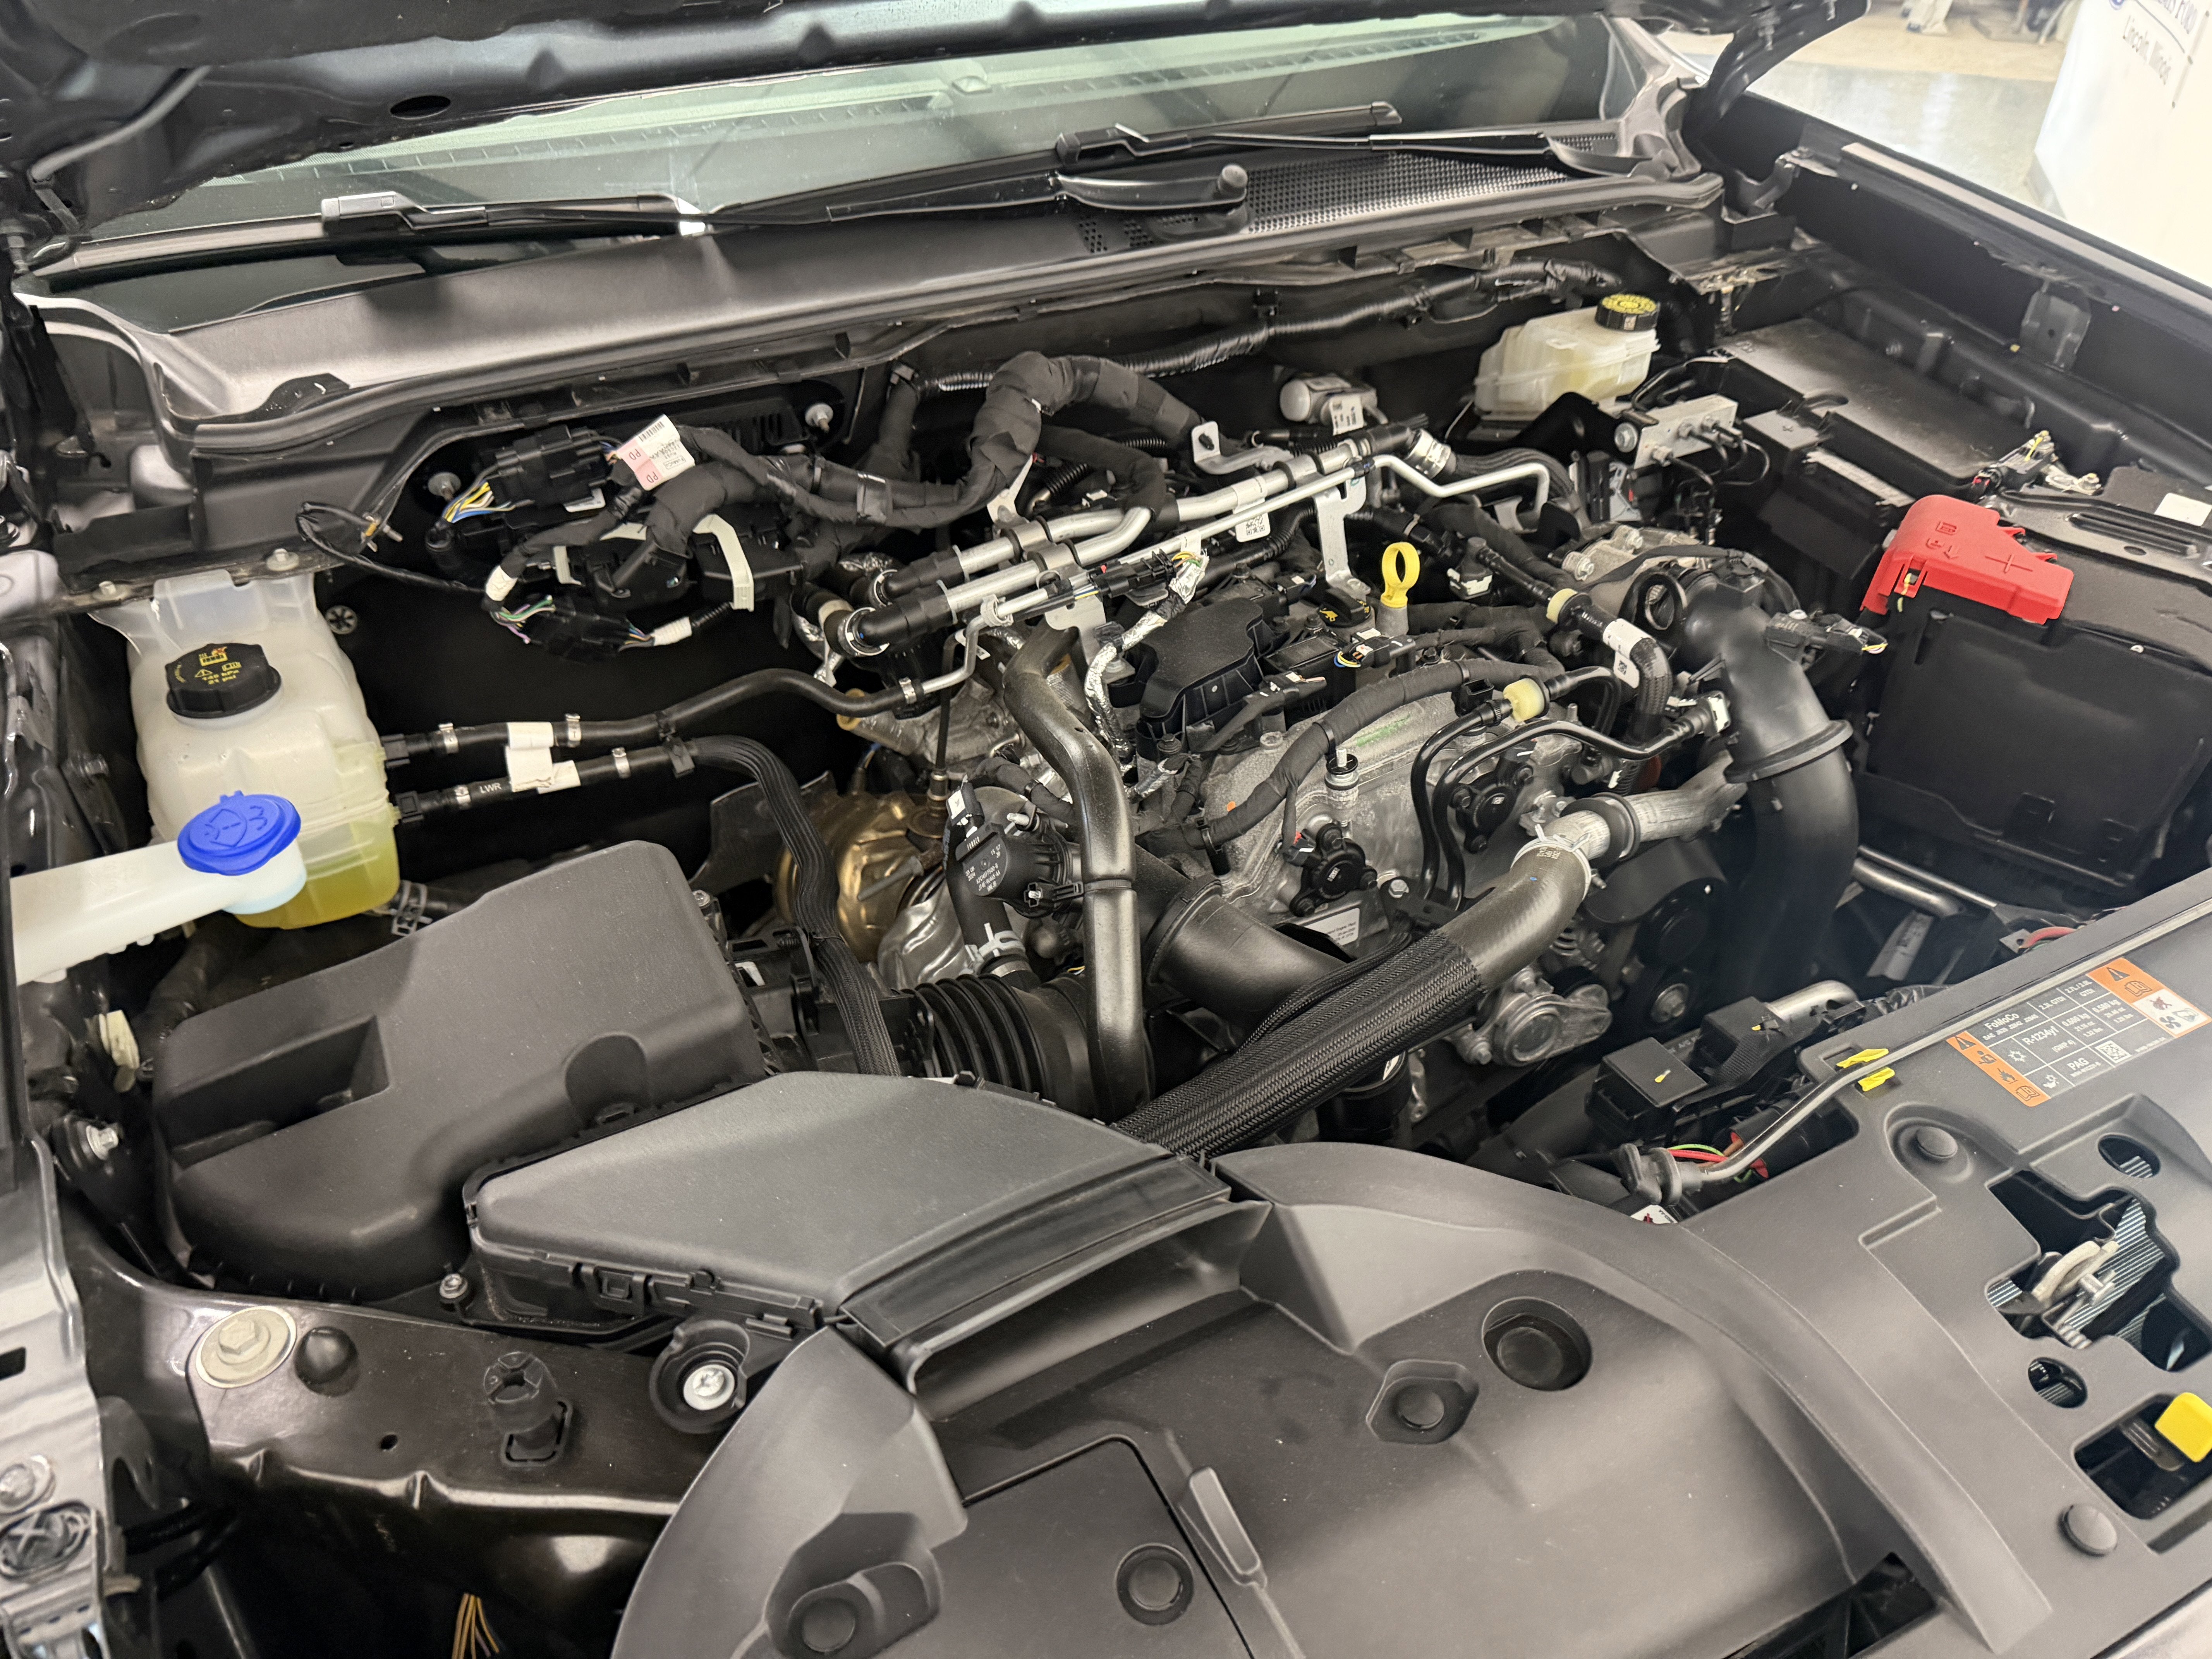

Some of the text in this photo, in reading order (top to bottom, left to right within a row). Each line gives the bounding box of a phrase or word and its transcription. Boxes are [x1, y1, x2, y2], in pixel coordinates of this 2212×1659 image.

[629, 448, 641, 460] PD
[646, 471, 658, 483] PD
[479, 782, 502, 793] LWR
[1984, 1013, 2020, 1030] FoMoCo
[2022, 1025, 2059, 1045] R-1234yf
[2067, 1057, 2090, 1071] PAG
